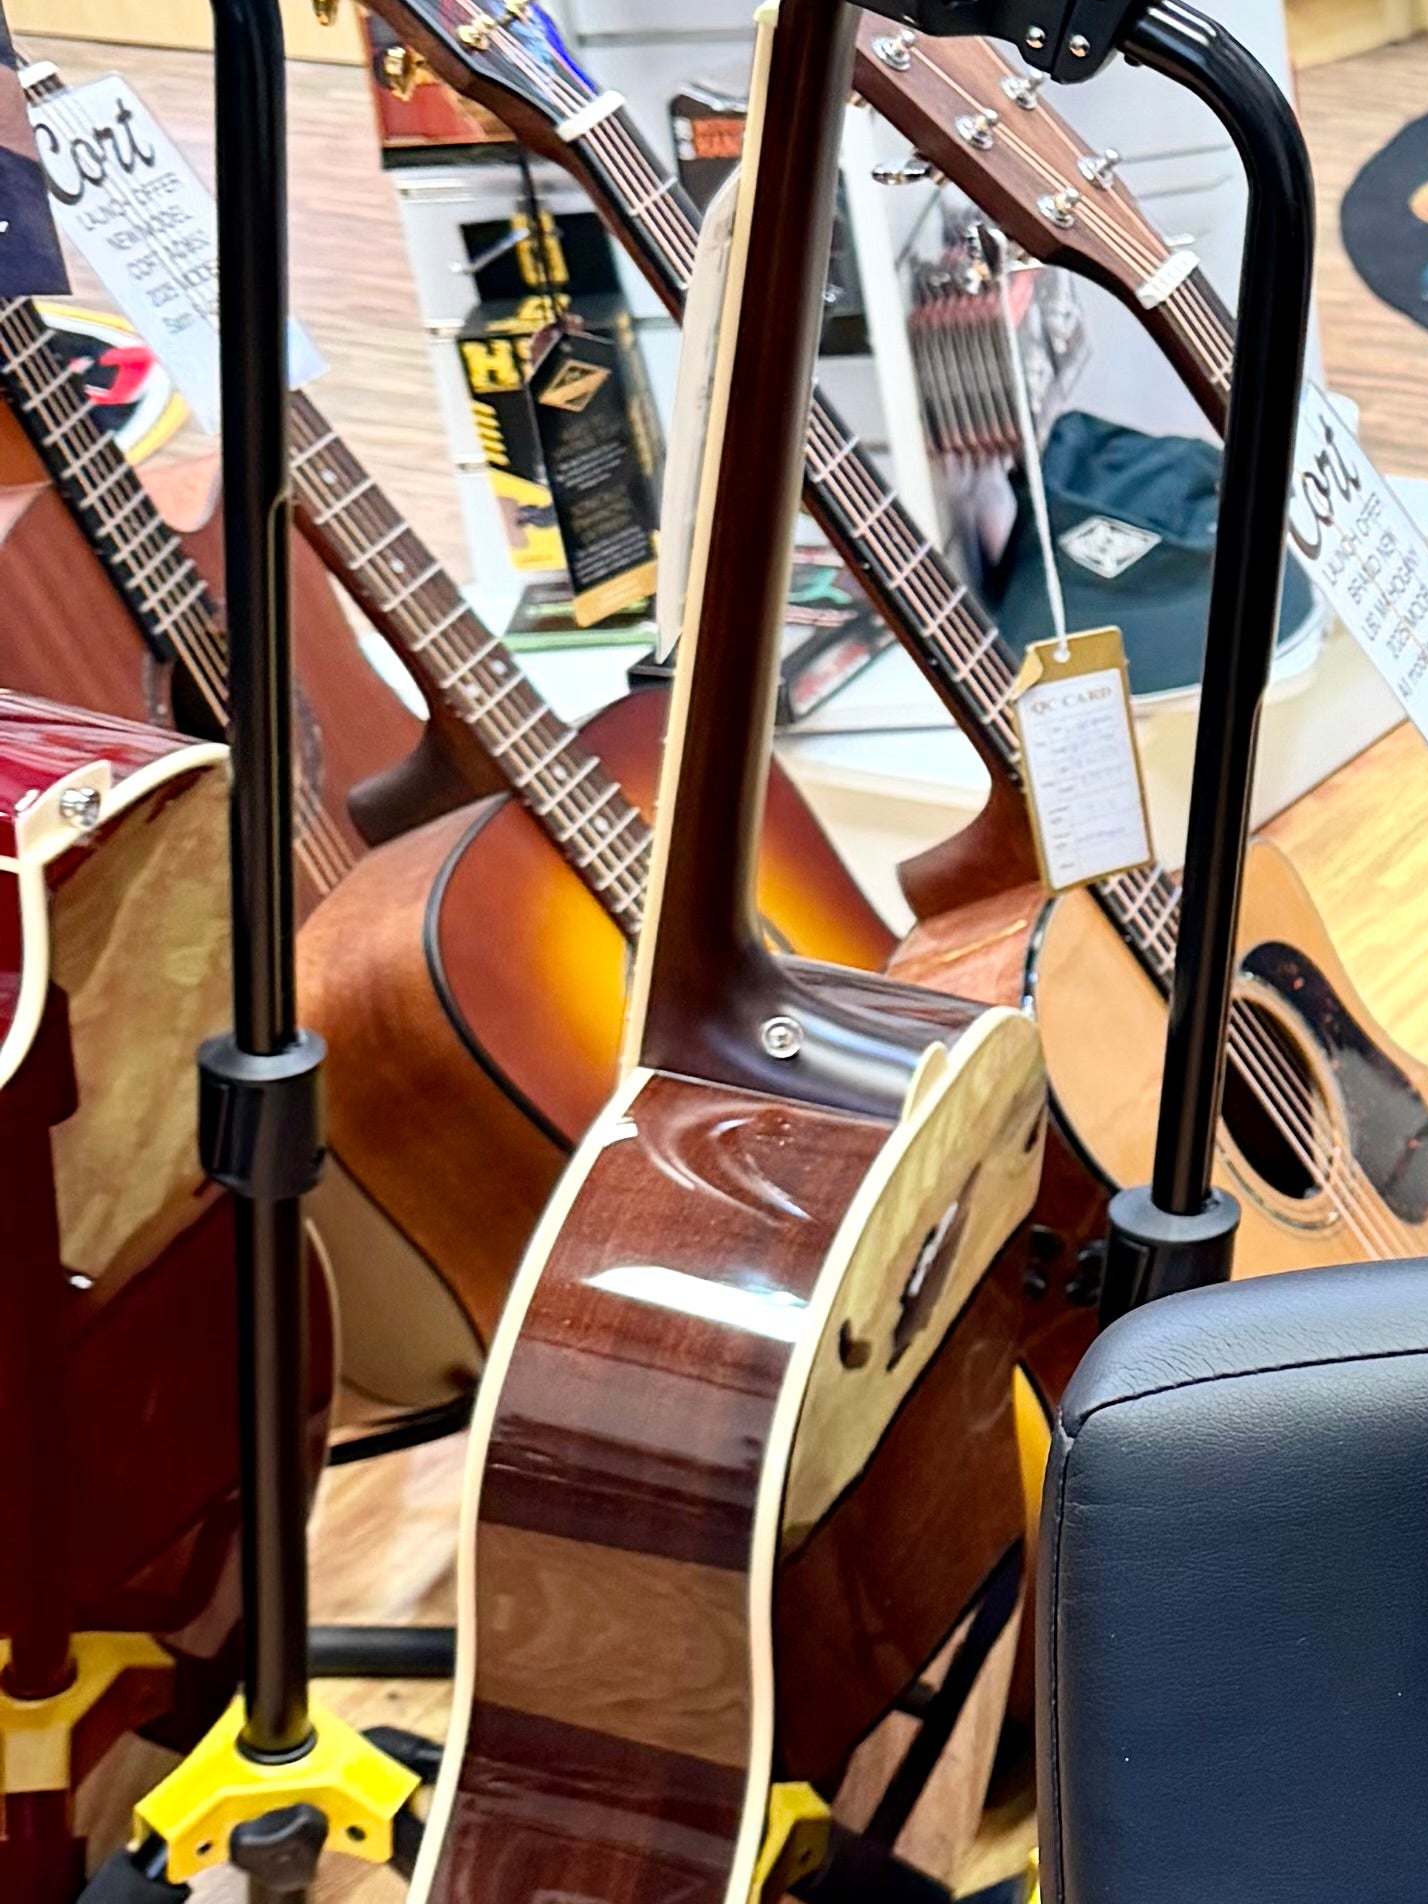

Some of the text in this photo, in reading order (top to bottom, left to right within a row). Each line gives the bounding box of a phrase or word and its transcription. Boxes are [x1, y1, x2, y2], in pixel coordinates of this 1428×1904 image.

[35, 96, 155, 207] Cort
[1323, 491, 1385, 587] LAUNCH OFFER
